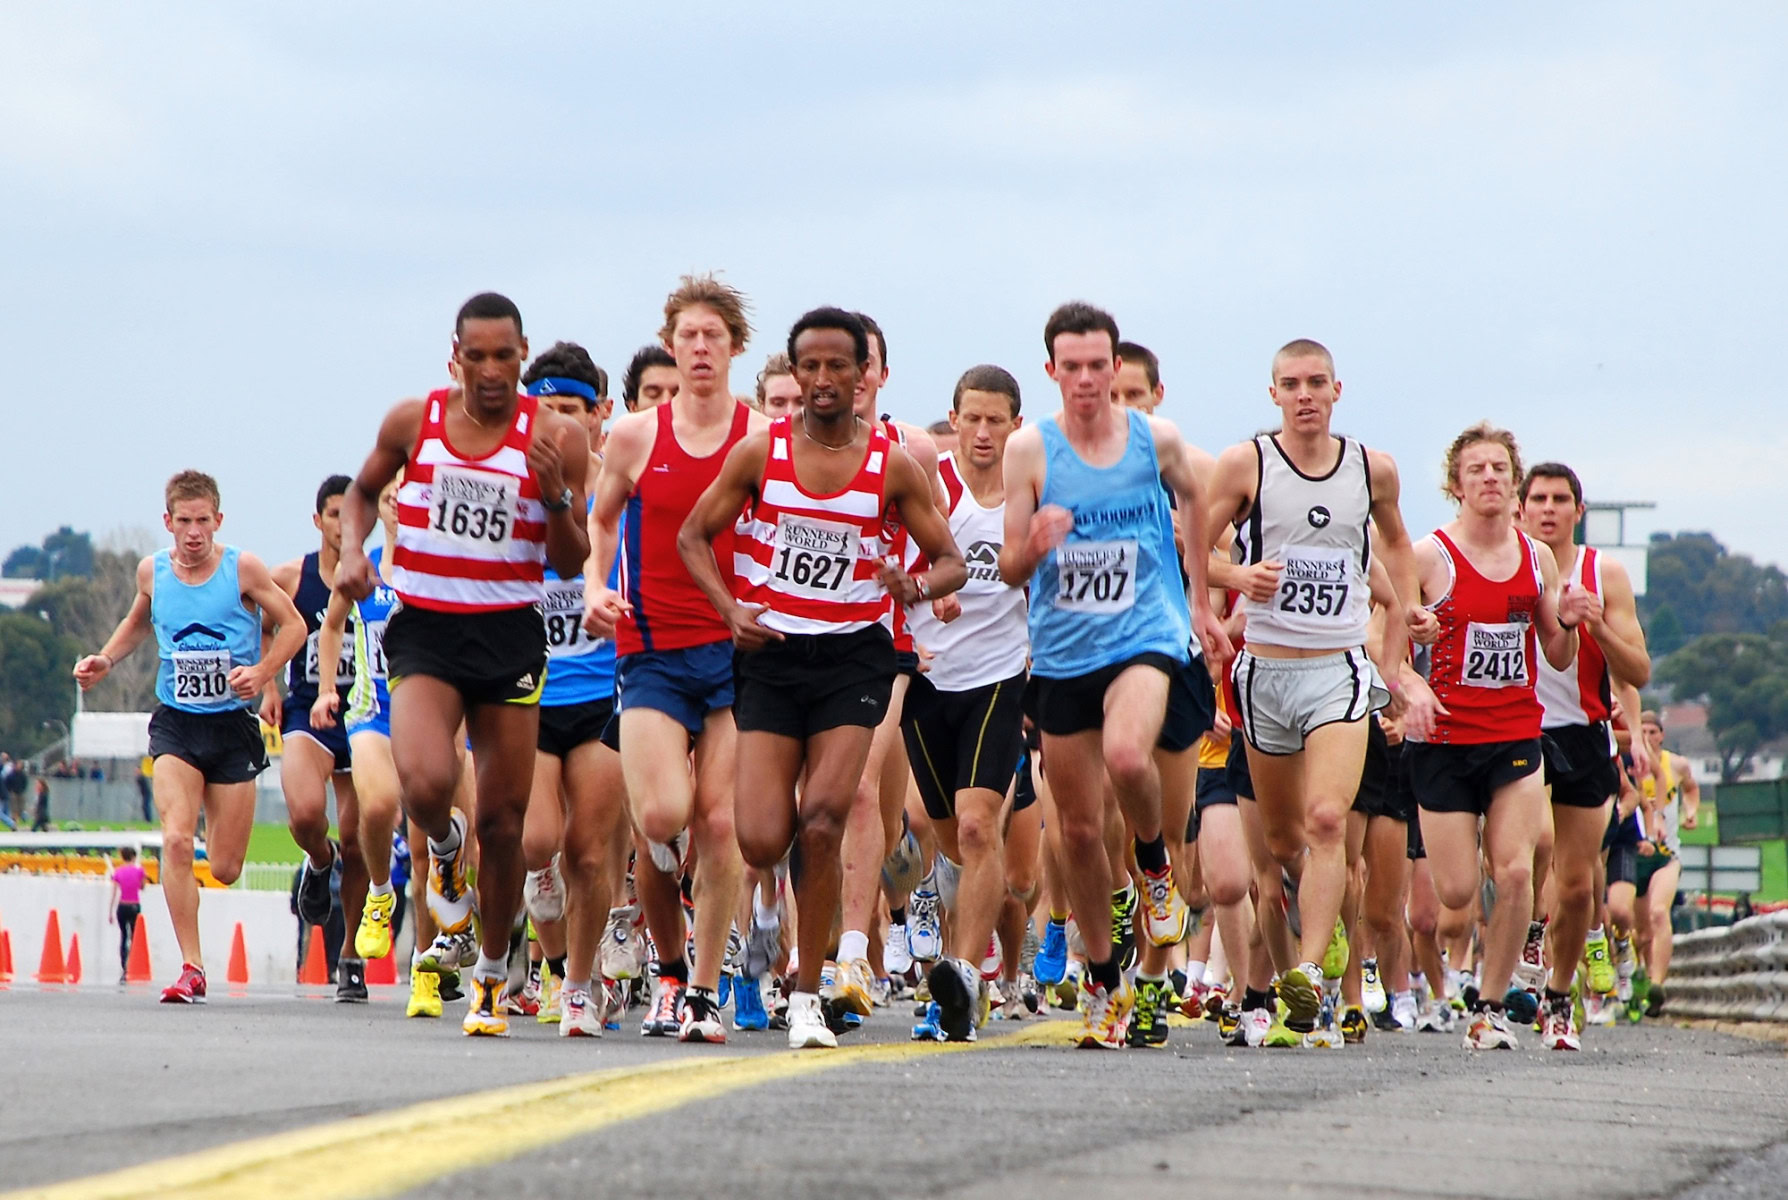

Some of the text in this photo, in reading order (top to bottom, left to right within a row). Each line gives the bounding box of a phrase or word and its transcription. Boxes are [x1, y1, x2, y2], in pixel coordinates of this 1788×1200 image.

[434, 499, 508, 542] 1635
[783, 533, 828, 549] WORLD
[784, 523, 842, 542] RUNNERS
[775, 547, 850, 591] 1627
[1286, 559, 1339, 571] RUNNERS
[1286, 568, 1329, 579] WORLD
[1061, 570, 1128, 602] 1707
[542, 600, 575, 610] ORLD
[1280, 581, 1349, 616] 2357
[1473, 631, 1516, 640] RUNNERS
[1473, 639, 1509, 648] WORLD
[1467, 651, 1525, 681] 2412
[177, 672, 227, 698] 2310
